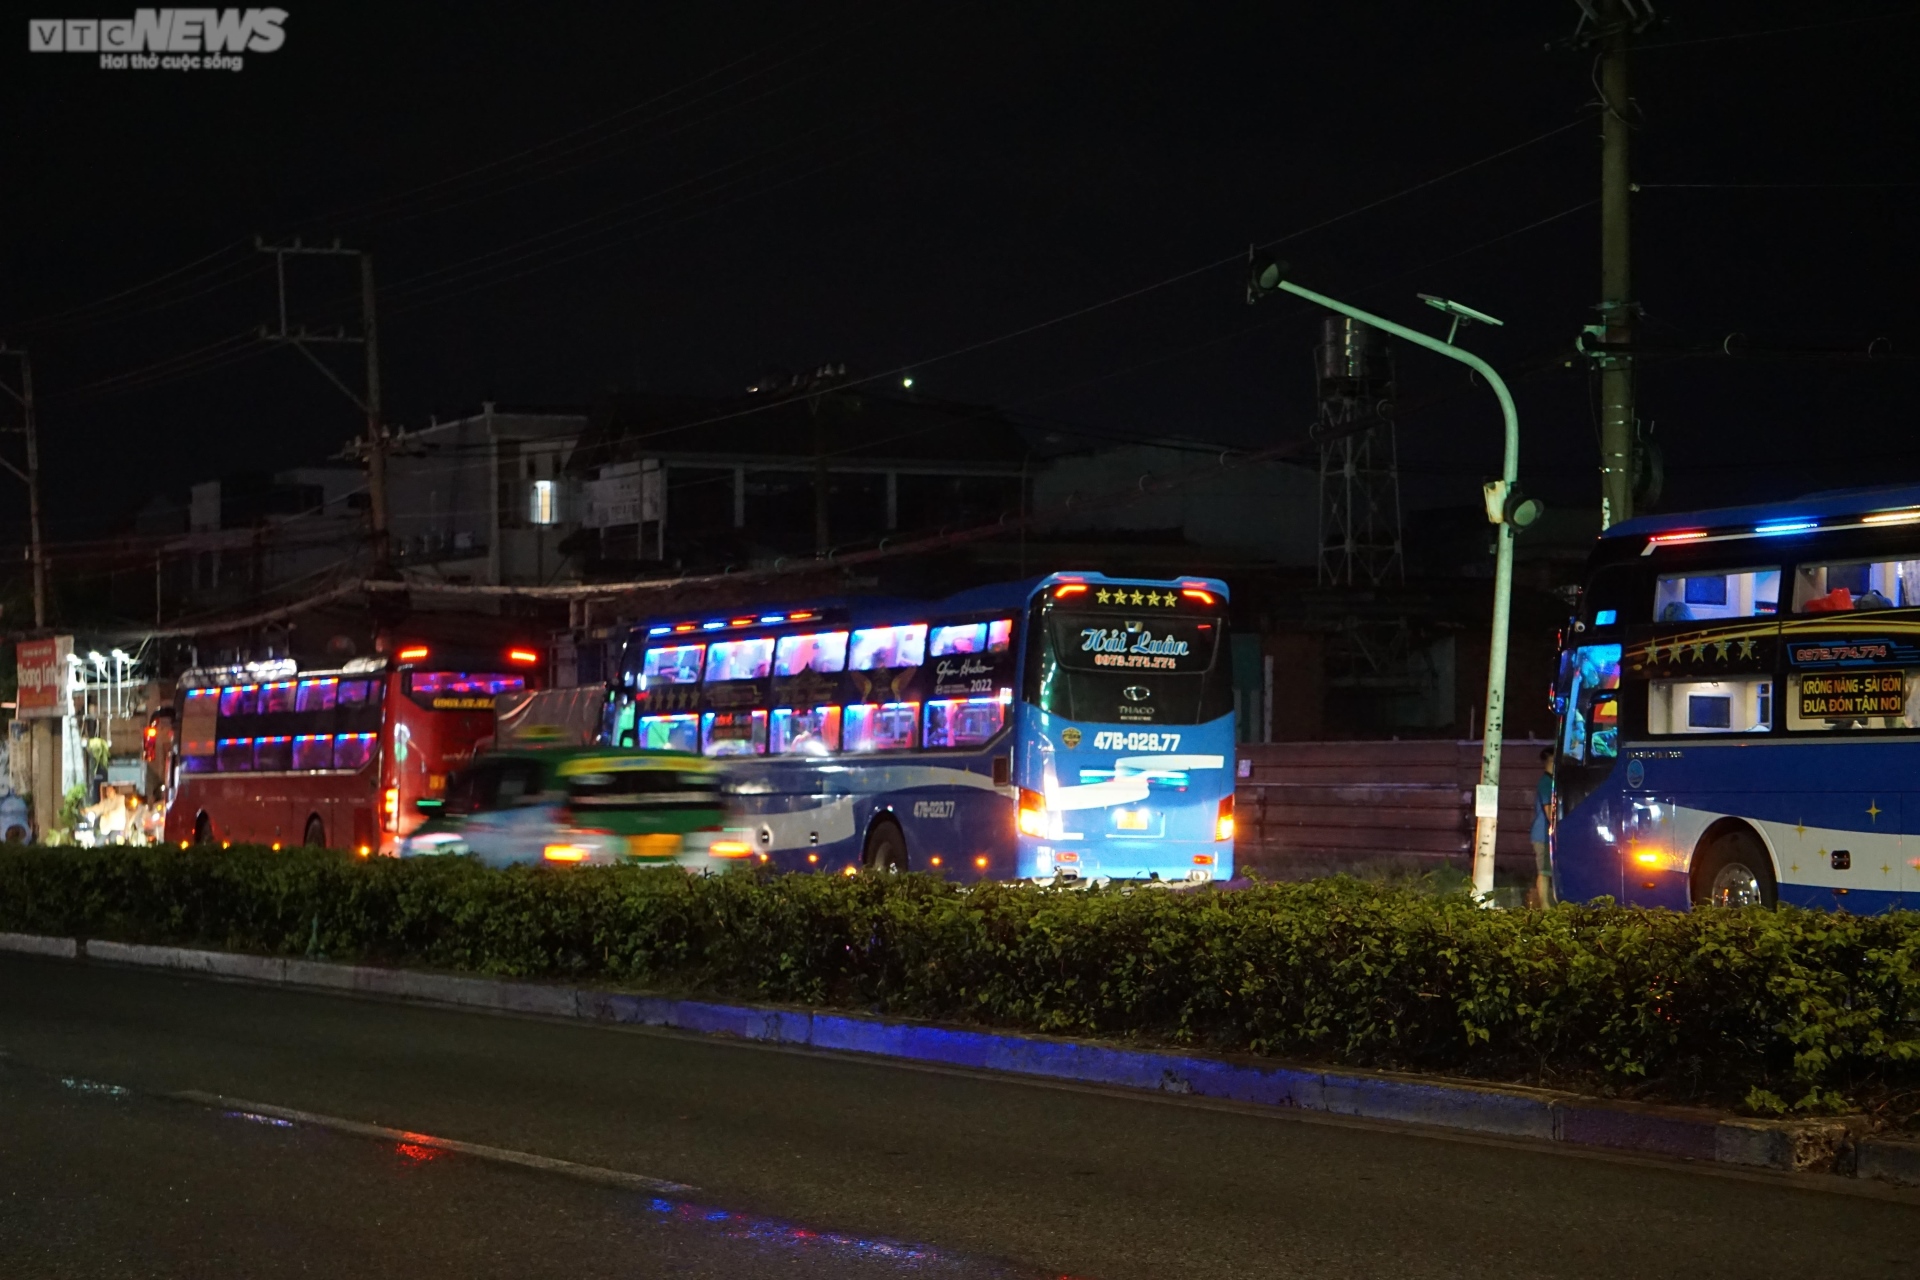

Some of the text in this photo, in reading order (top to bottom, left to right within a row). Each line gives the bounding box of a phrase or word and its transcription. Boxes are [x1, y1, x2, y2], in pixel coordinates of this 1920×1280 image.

[1081, 627, 1189, 656] Hải Luân
[1796, 645, 1887, 661] 0972.774.774
[970, 678, 992, 692] 2022
[1803, 677, 1832, 694] KRÔNG
[1865, 674, 1880, 692] SÀI
[1882, 674, 1901, 692] GÒN
[1118, 705, 1155, 714] THACO
[1803, 694, 1901, 714] ĐƯA ĐÓN TẬN NƠI
